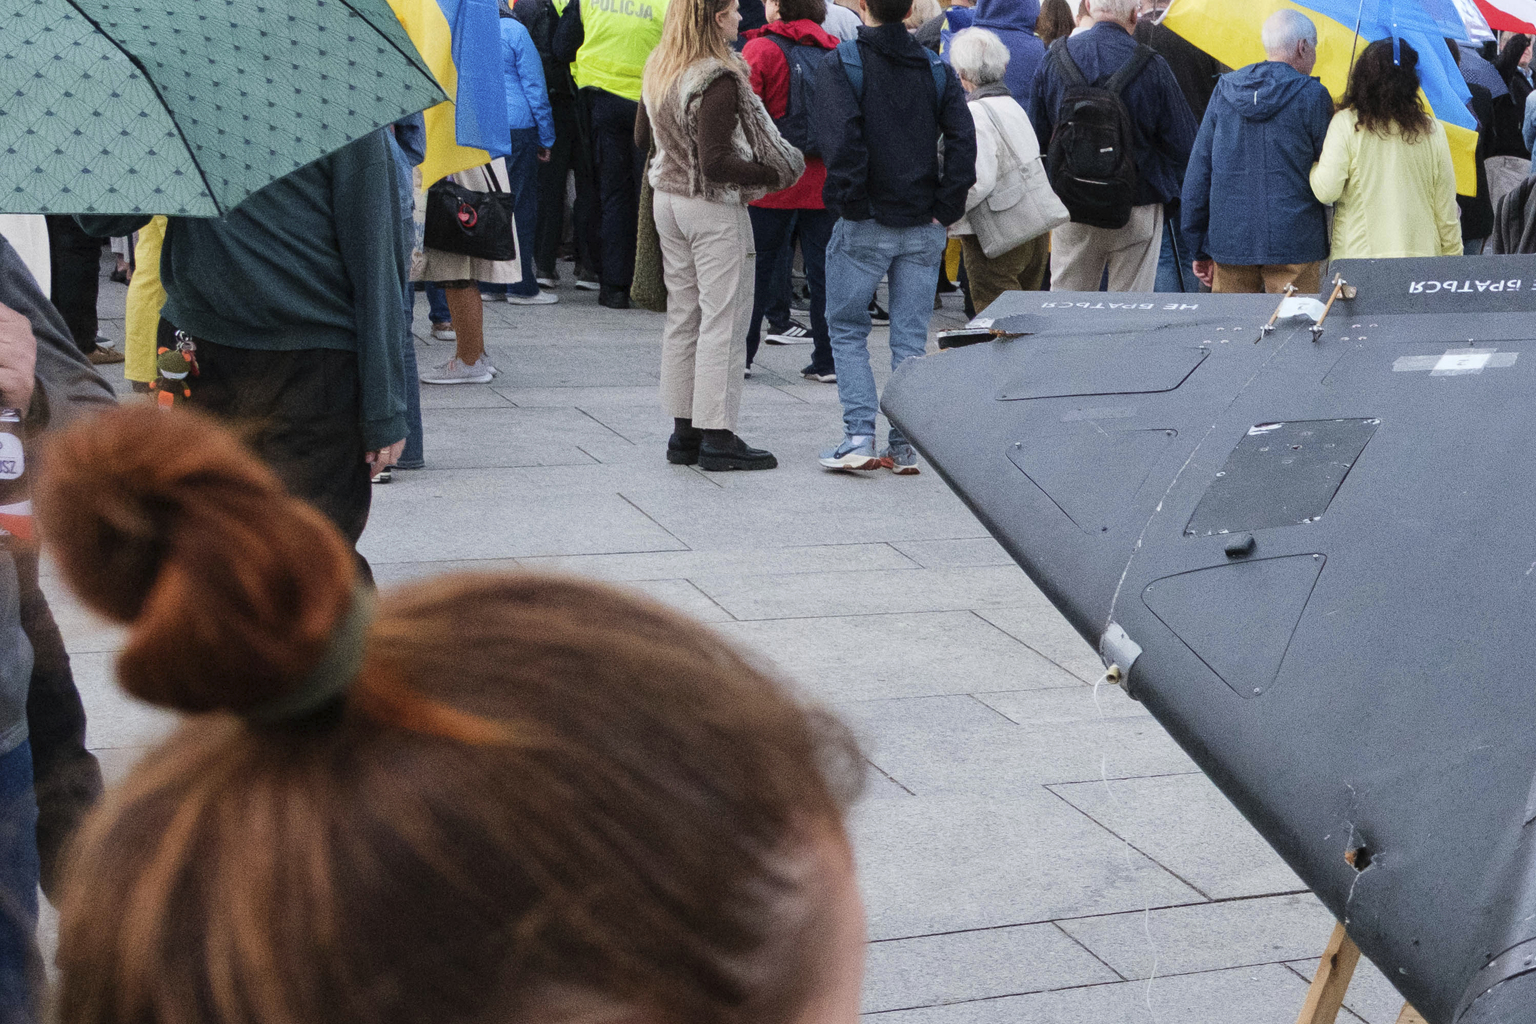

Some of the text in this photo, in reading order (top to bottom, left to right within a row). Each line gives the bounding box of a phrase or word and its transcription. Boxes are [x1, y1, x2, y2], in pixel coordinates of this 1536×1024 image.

[591, 0, 653, 21] POLICJA
[1408, 279, 1521, 294] БРАТЬСЯ
[1041, 302, 1199, 311] НЕ БРАТЬСЯ
